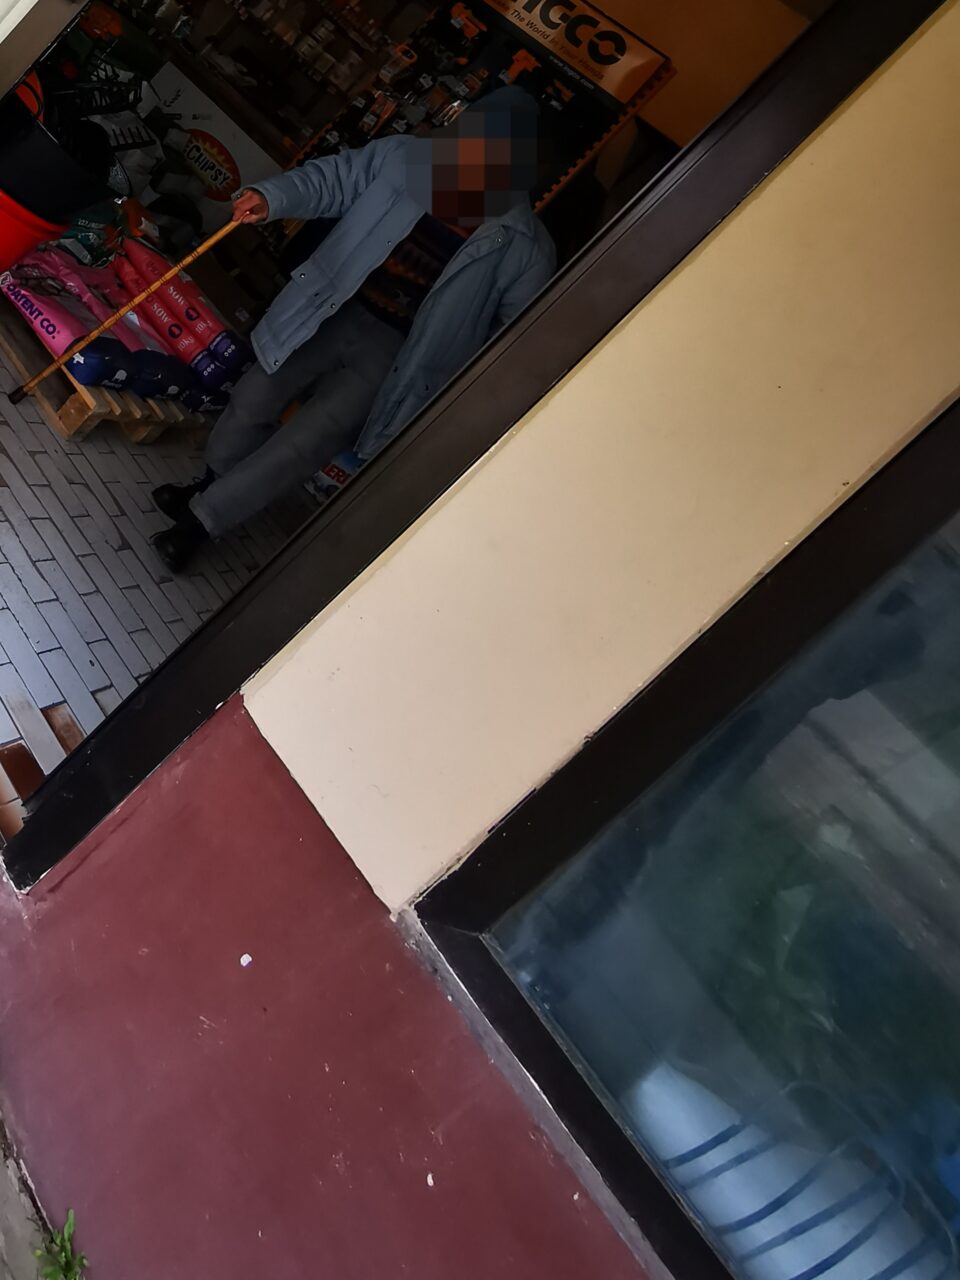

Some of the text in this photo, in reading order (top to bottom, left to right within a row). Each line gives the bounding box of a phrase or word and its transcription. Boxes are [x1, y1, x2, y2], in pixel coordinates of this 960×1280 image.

[511, 8, 526, 23] The
[526, 19, 551, 41] World
[152, 303, 171, 323] SOW
